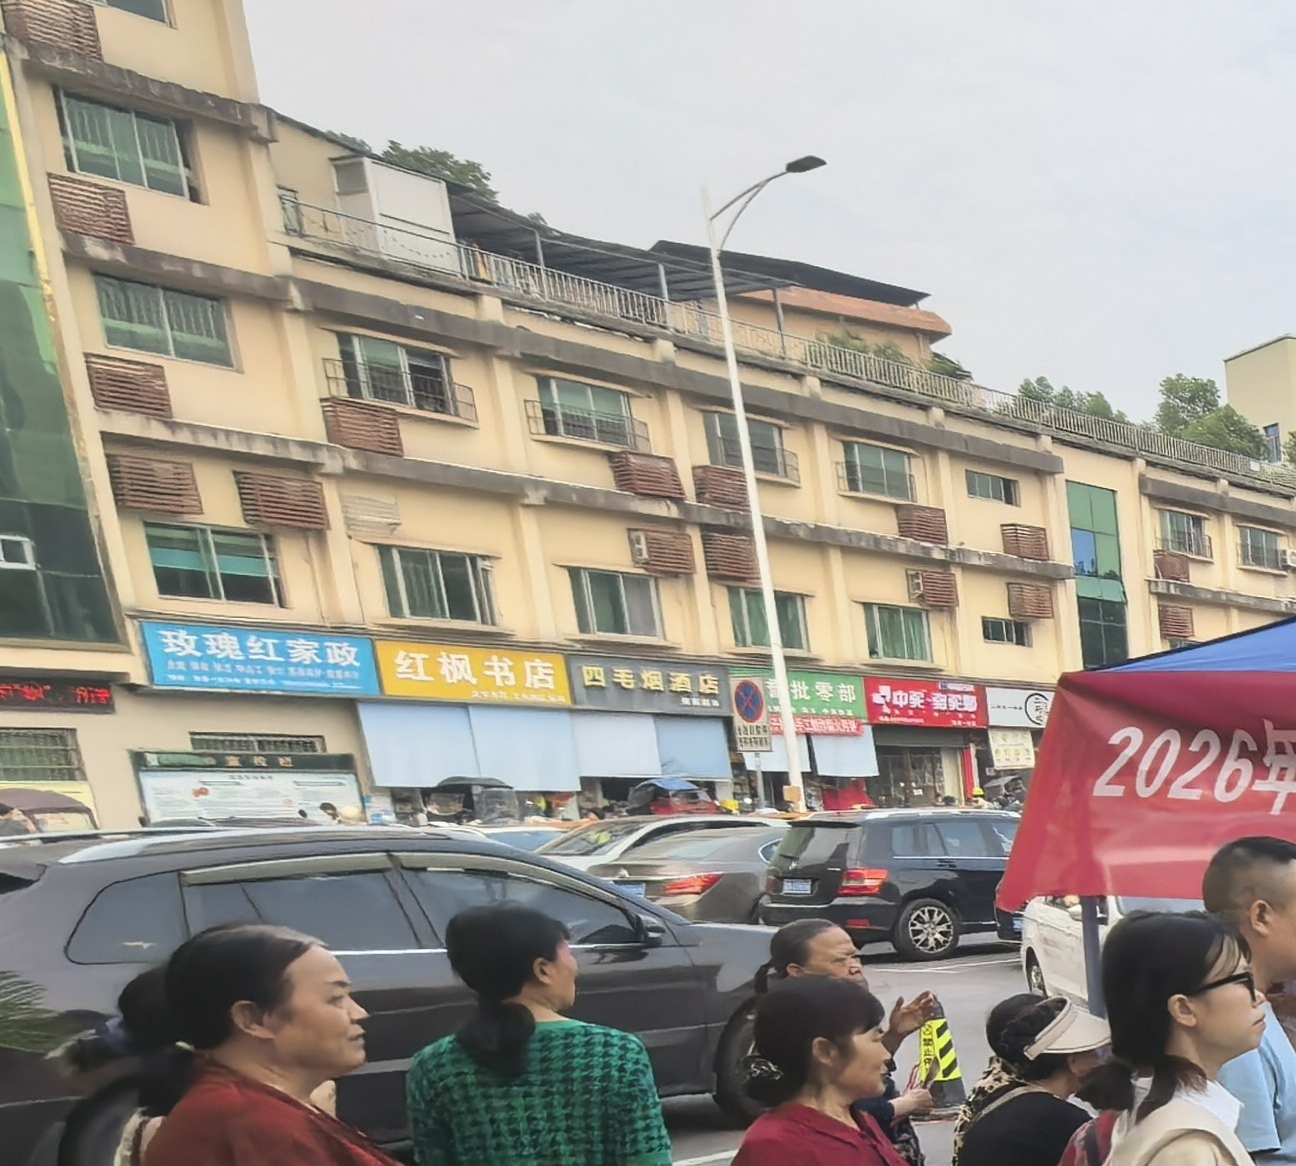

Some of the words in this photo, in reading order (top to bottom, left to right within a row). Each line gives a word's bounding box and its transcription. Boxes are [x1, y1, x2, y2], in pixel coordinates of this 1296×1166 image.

[158, 629, 361, 667] 玫瑰红家政
[394, 650, 556, 690] 红枫书店
[582, 664, 720, 696] 四毛烟酒店
